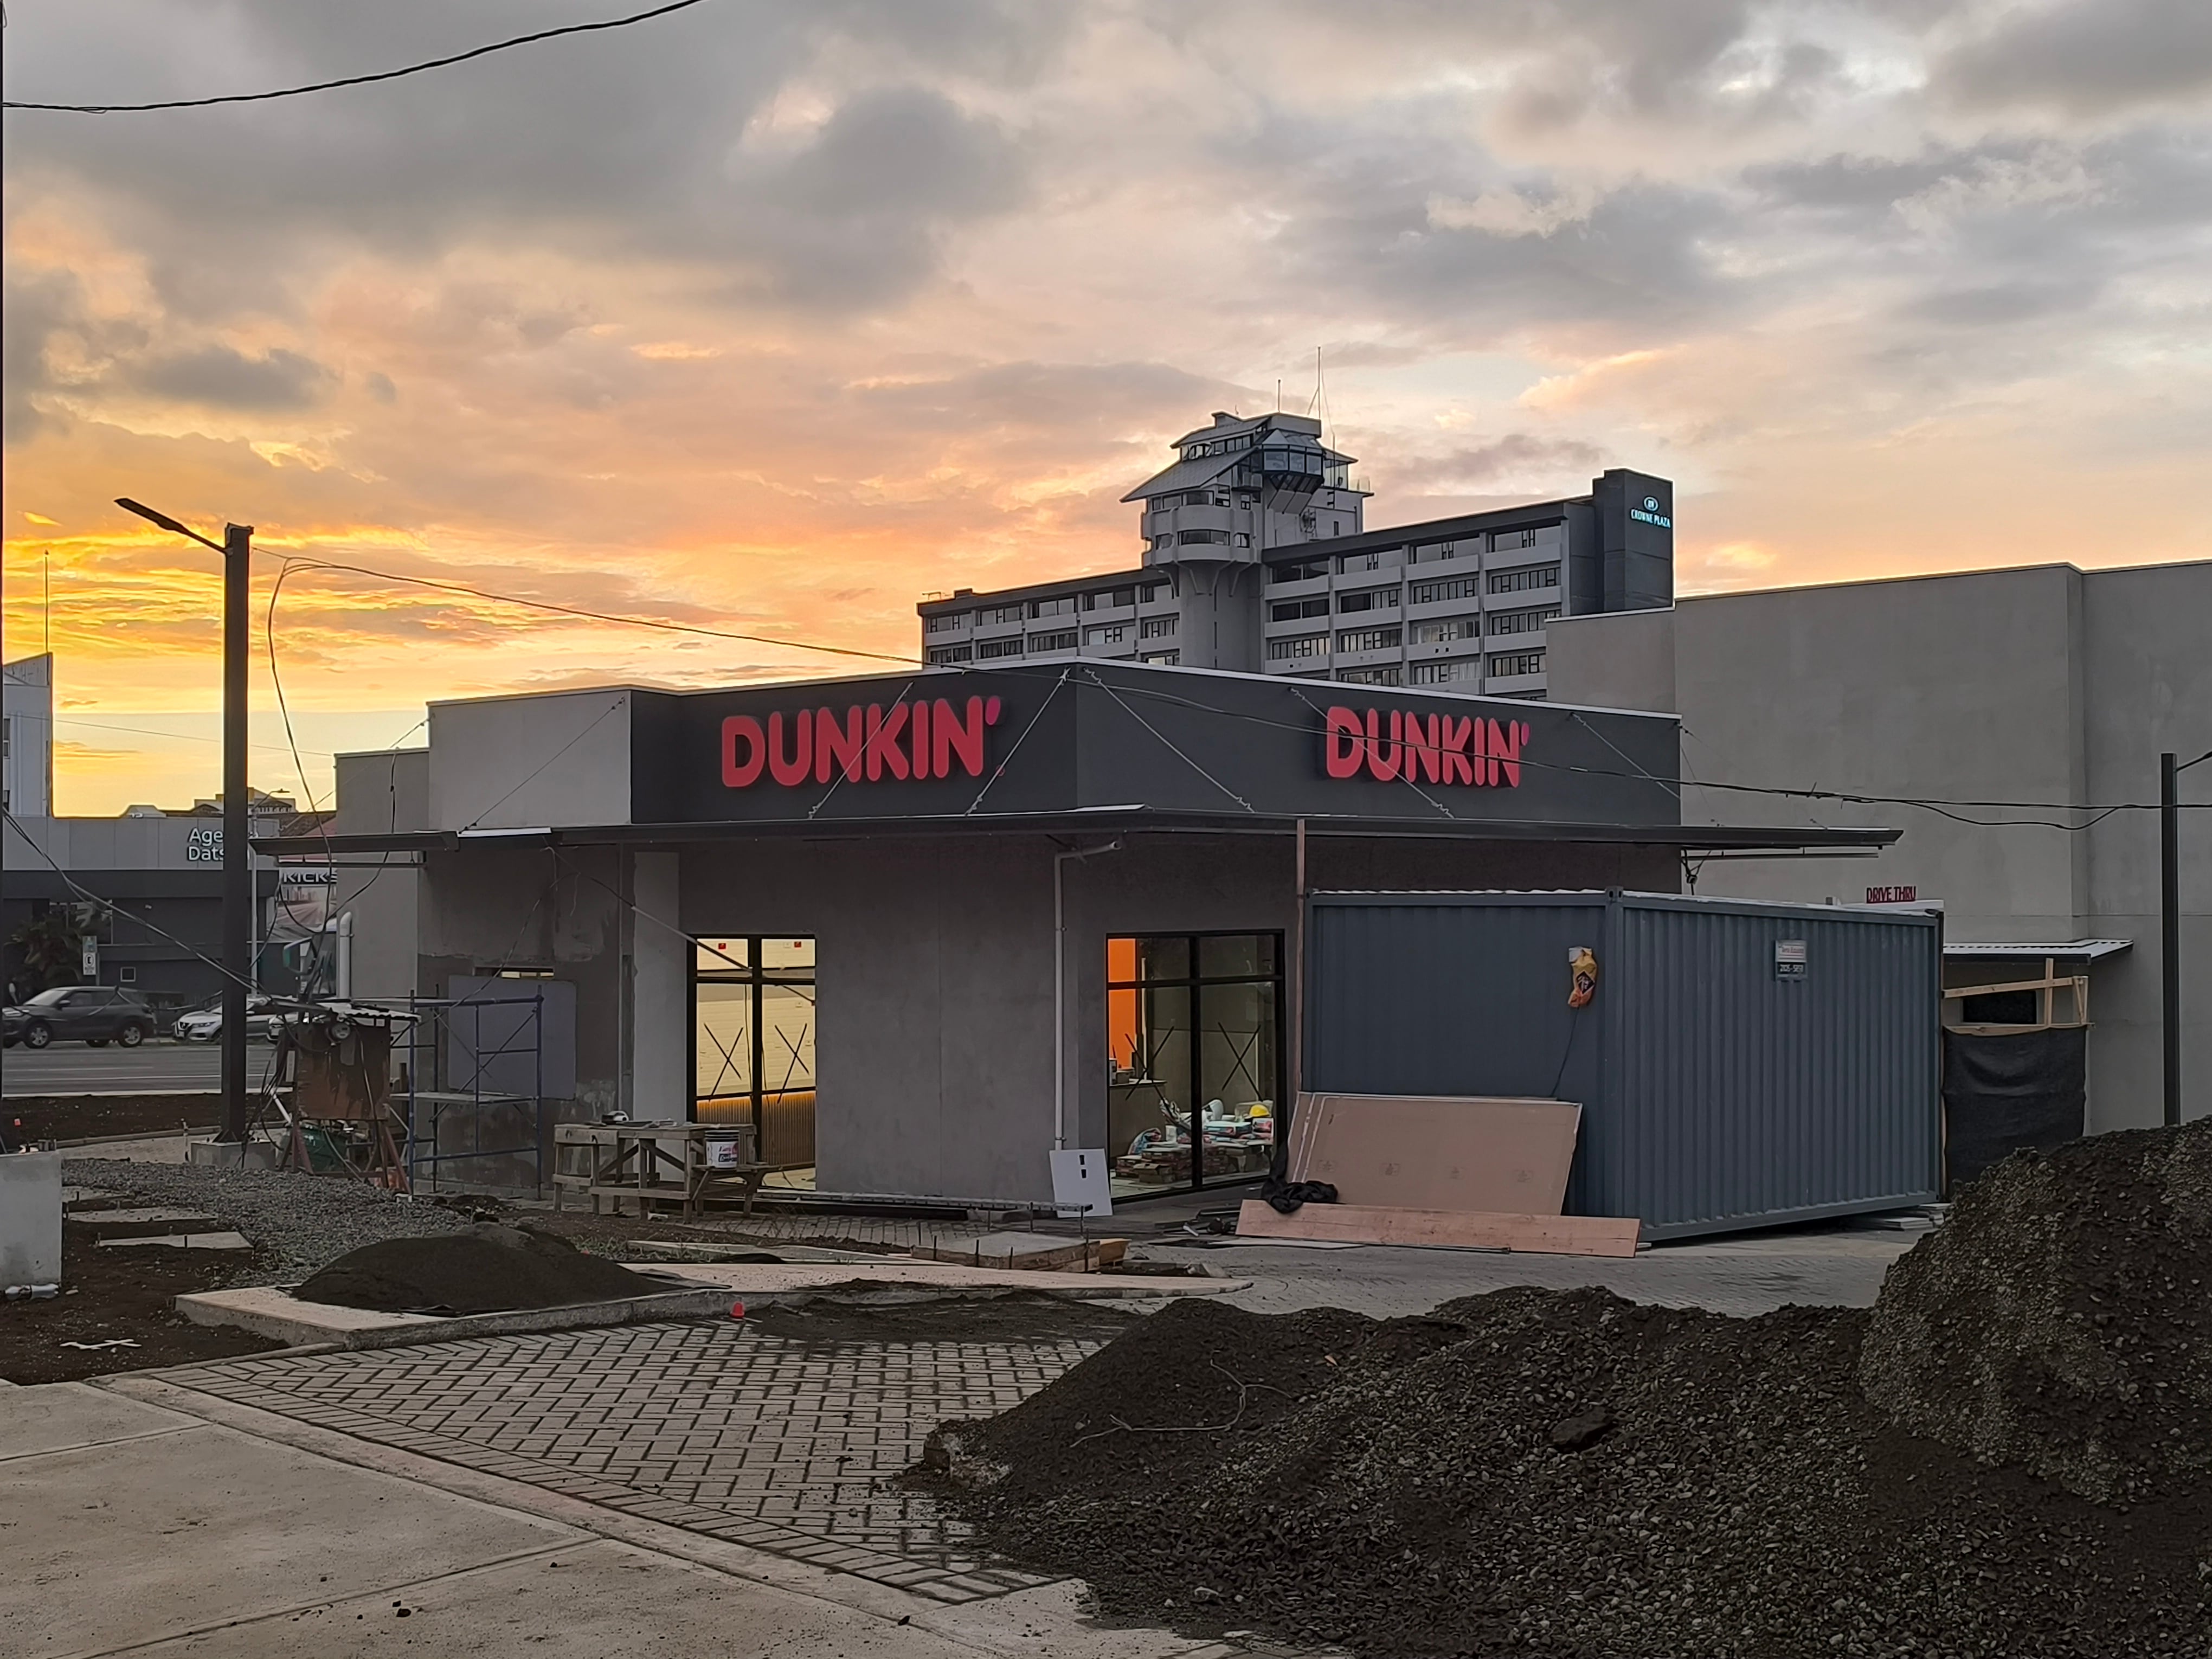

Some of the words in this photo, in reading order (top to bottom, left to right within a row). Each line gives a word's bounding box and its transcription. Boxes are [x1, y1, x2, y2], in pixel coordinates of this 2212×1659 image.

[1631, 509, 1653, 524] CROWNE
[1654, 513, 1671, 529] PLAZA
[722, 695, 1001, 788] DUNKIN'
[1326, 706, 1530, 788] DUNKIN'
[188, 827, 224, 847] Age
[188, 846, 224, 861] Dats
[1866, 886, 1893, 904] DRIVE
[1894, 885, 1917, 902] THRU
